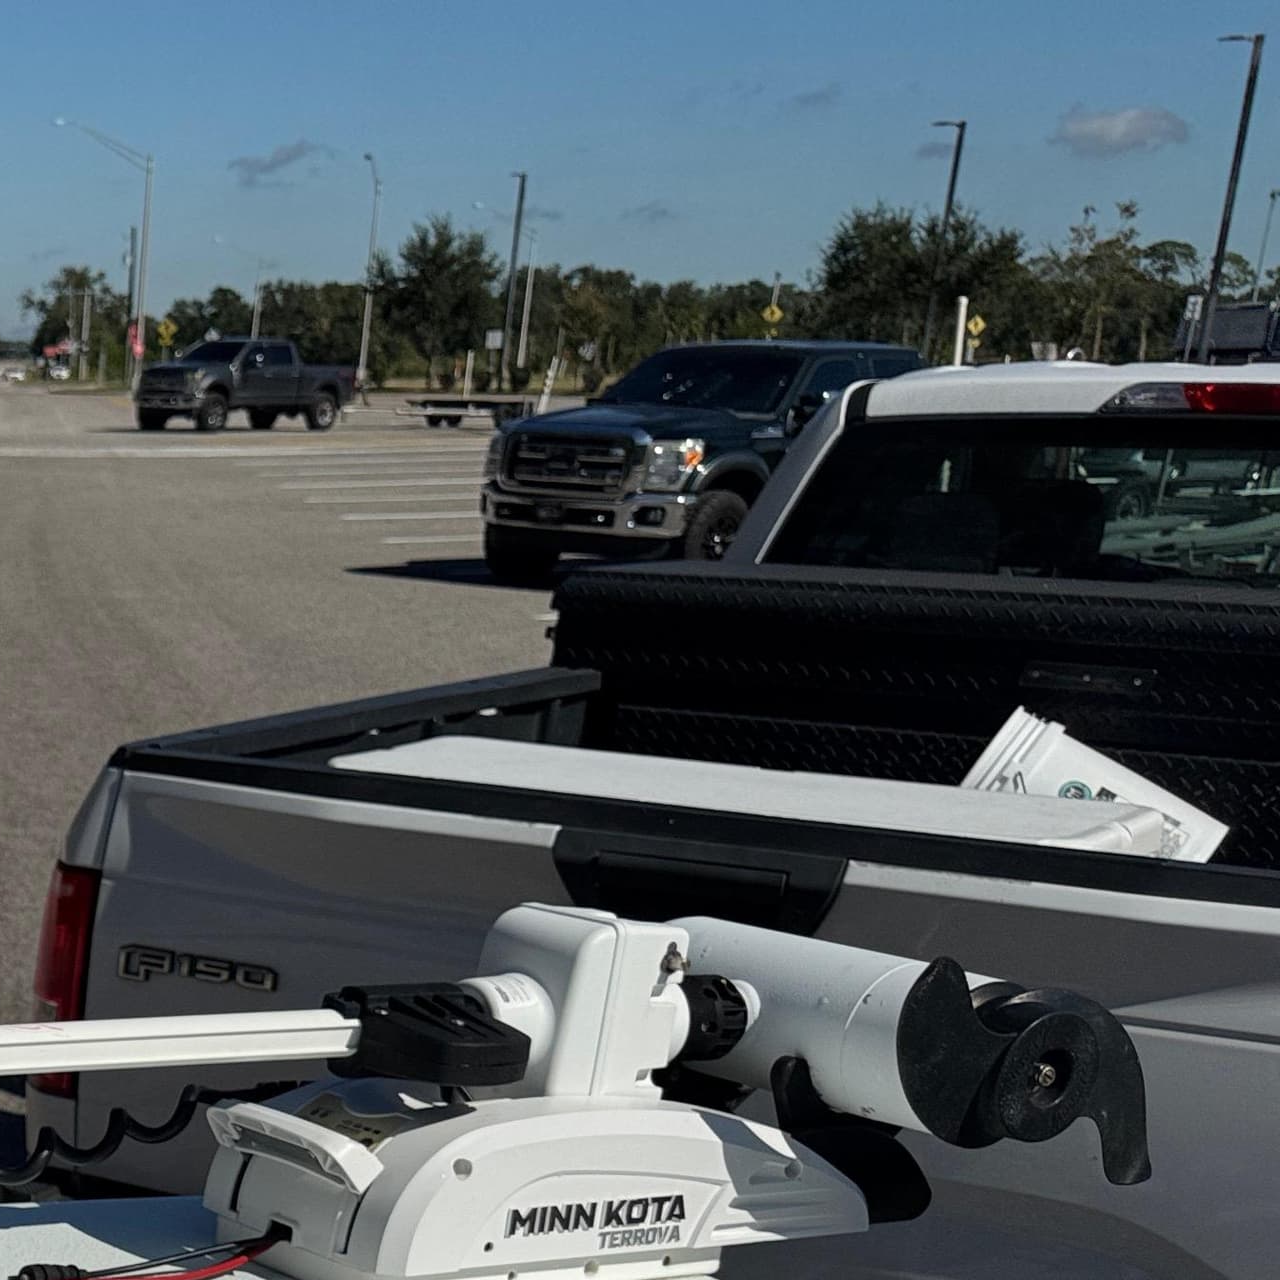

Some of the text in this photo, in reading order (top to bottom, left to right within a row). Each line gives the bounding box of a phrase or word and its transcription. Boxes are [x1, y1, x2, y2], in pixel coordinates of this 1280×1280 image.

[505, 1195, 686, 1238] MINN KOTA
[599, 1225, 681, 1249] TERROVA
